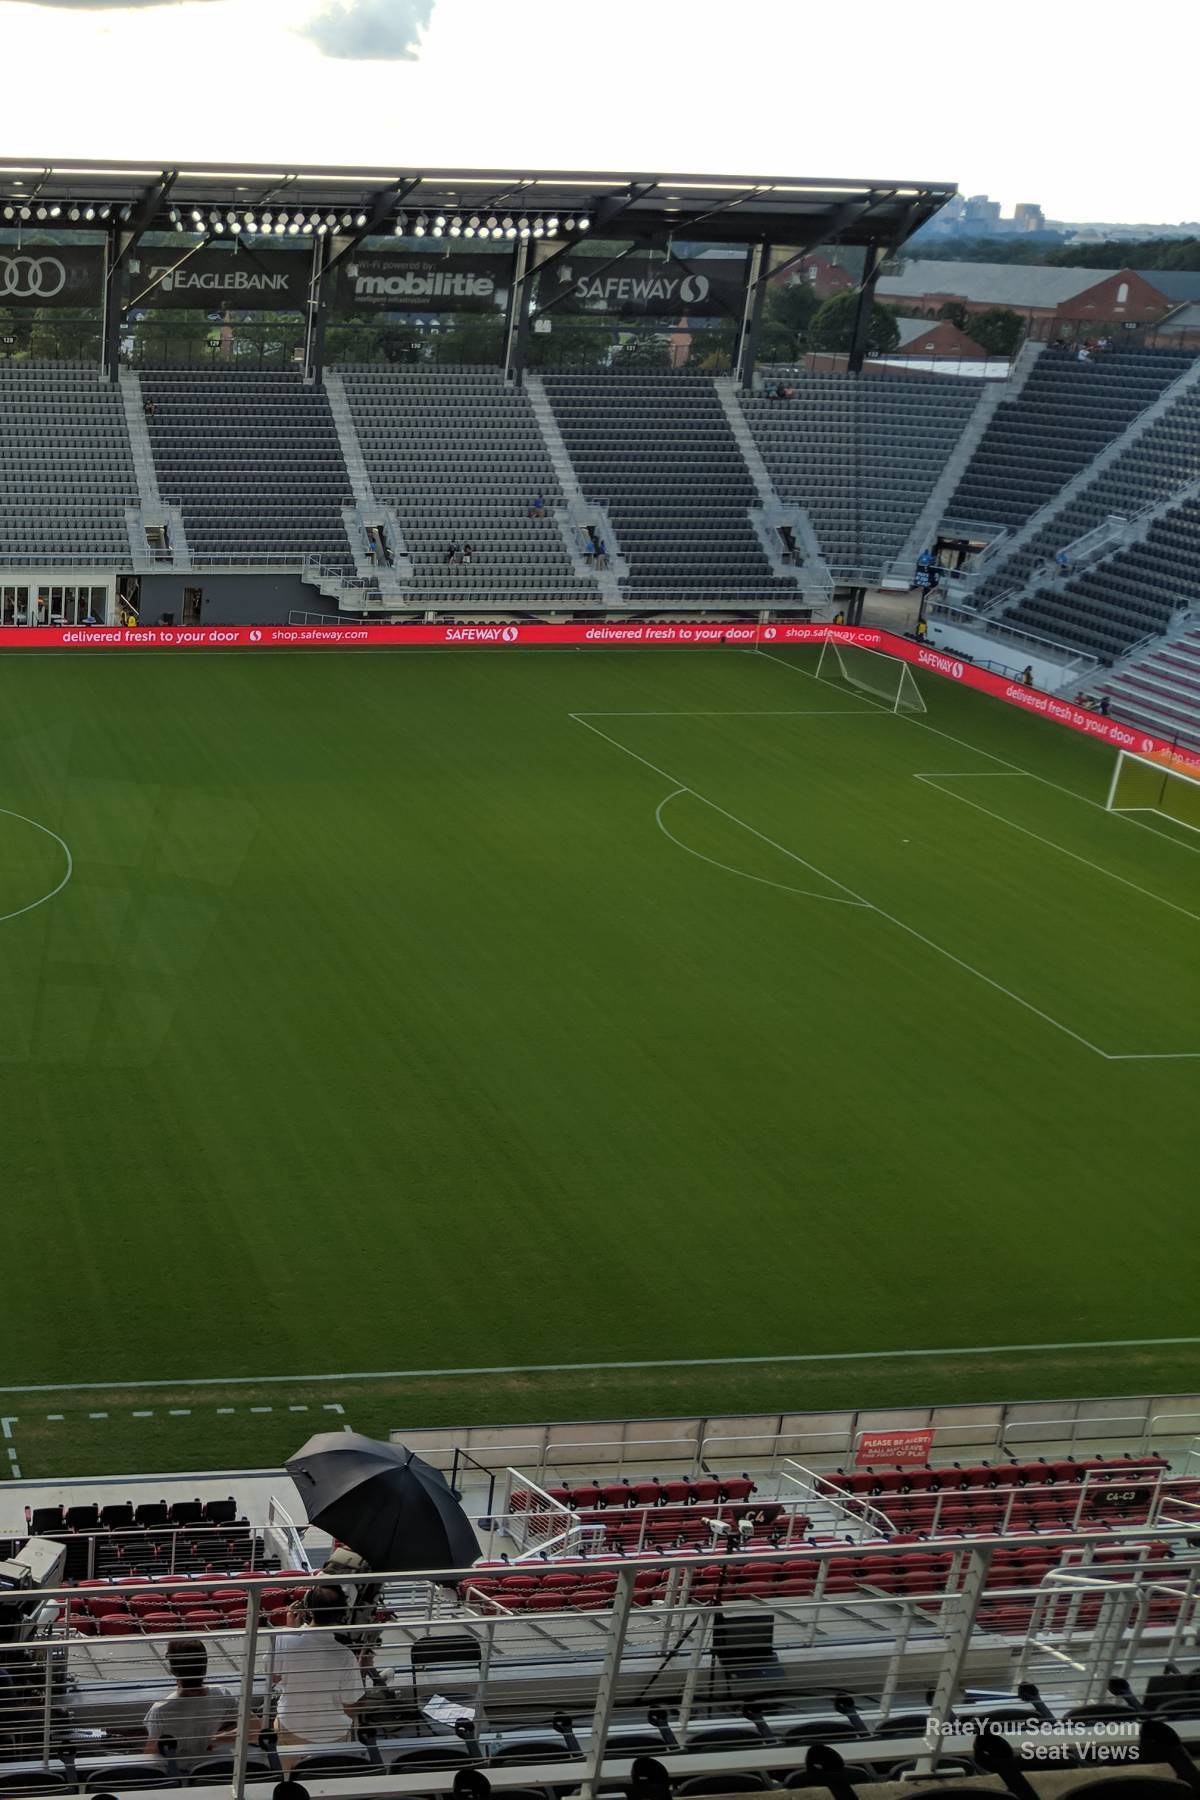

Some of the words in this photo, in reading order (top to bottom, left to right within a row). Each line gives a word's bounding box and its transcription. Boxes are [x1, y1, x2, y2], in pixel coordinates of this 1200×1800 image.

[383, 261, 420, 271] powered
[355, 271, 495, 296] mobilitie
[575, 277, 679, 299] SAFEWAY
[63, 631, 121, 642] delivered
[125, 631, 156, 642] fresh
[160, 631, 173, 642] to
[176, 632, 206, 643] your
[209, 630, 239, 641] door
[272, 630, 368, 641] shop.safeway.com
[445, 629, 502, 641] SAFEWAY
[586, 628, 642, 639] delivered
[645, 628, 676, 639] fresh
[679, 628, 692, 638] to
[694, 629, 724, 640] your
[725, 628, 755, 639] door
[785, 628, 881, 642] shop.safeway.com
[918, 650, 953, 673] SAFEWAY
[1006, 685, 1047, 710] delivered
[1049, 701, 1072, 721] fresh
[1073, 713, 1084, 725] to
[1085, 718, 1108, 734] your
[1110, 726, 1136, 744] door
[864, 1439, 892, 1447] PLEASE
[1106, 1491, 1136, 1501] C4-C3
[745, 1510, 766, 1522] C4
